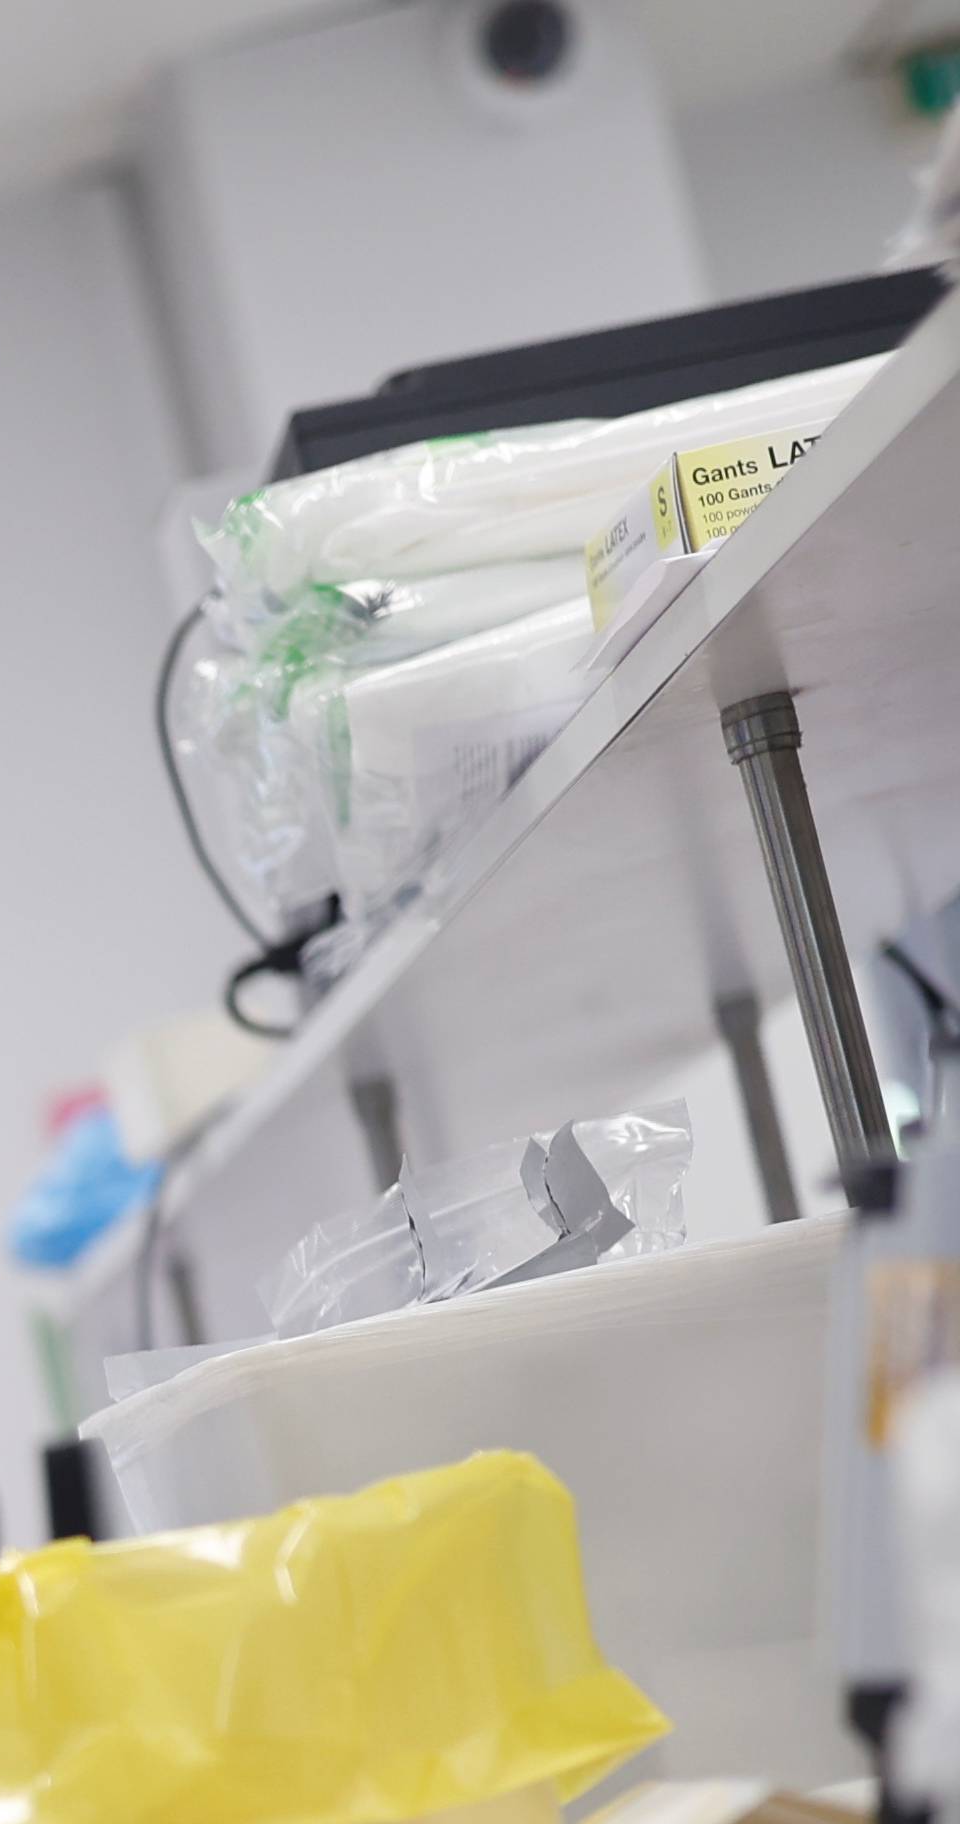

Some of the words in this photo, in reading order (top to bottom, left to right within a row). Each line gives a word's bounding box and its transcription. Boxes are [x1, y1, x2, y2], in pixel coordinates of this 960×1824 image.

[691, 459, 759, 486] Gants
[657, 485, 668, 517] S
[698, 491, 725, 508] 100
[728, 482, 773, 501] Gants
[702, 510, 724, 524] 100
[604, 515, 629, 555] LATEX
[706, 525, 728, 539] 100
